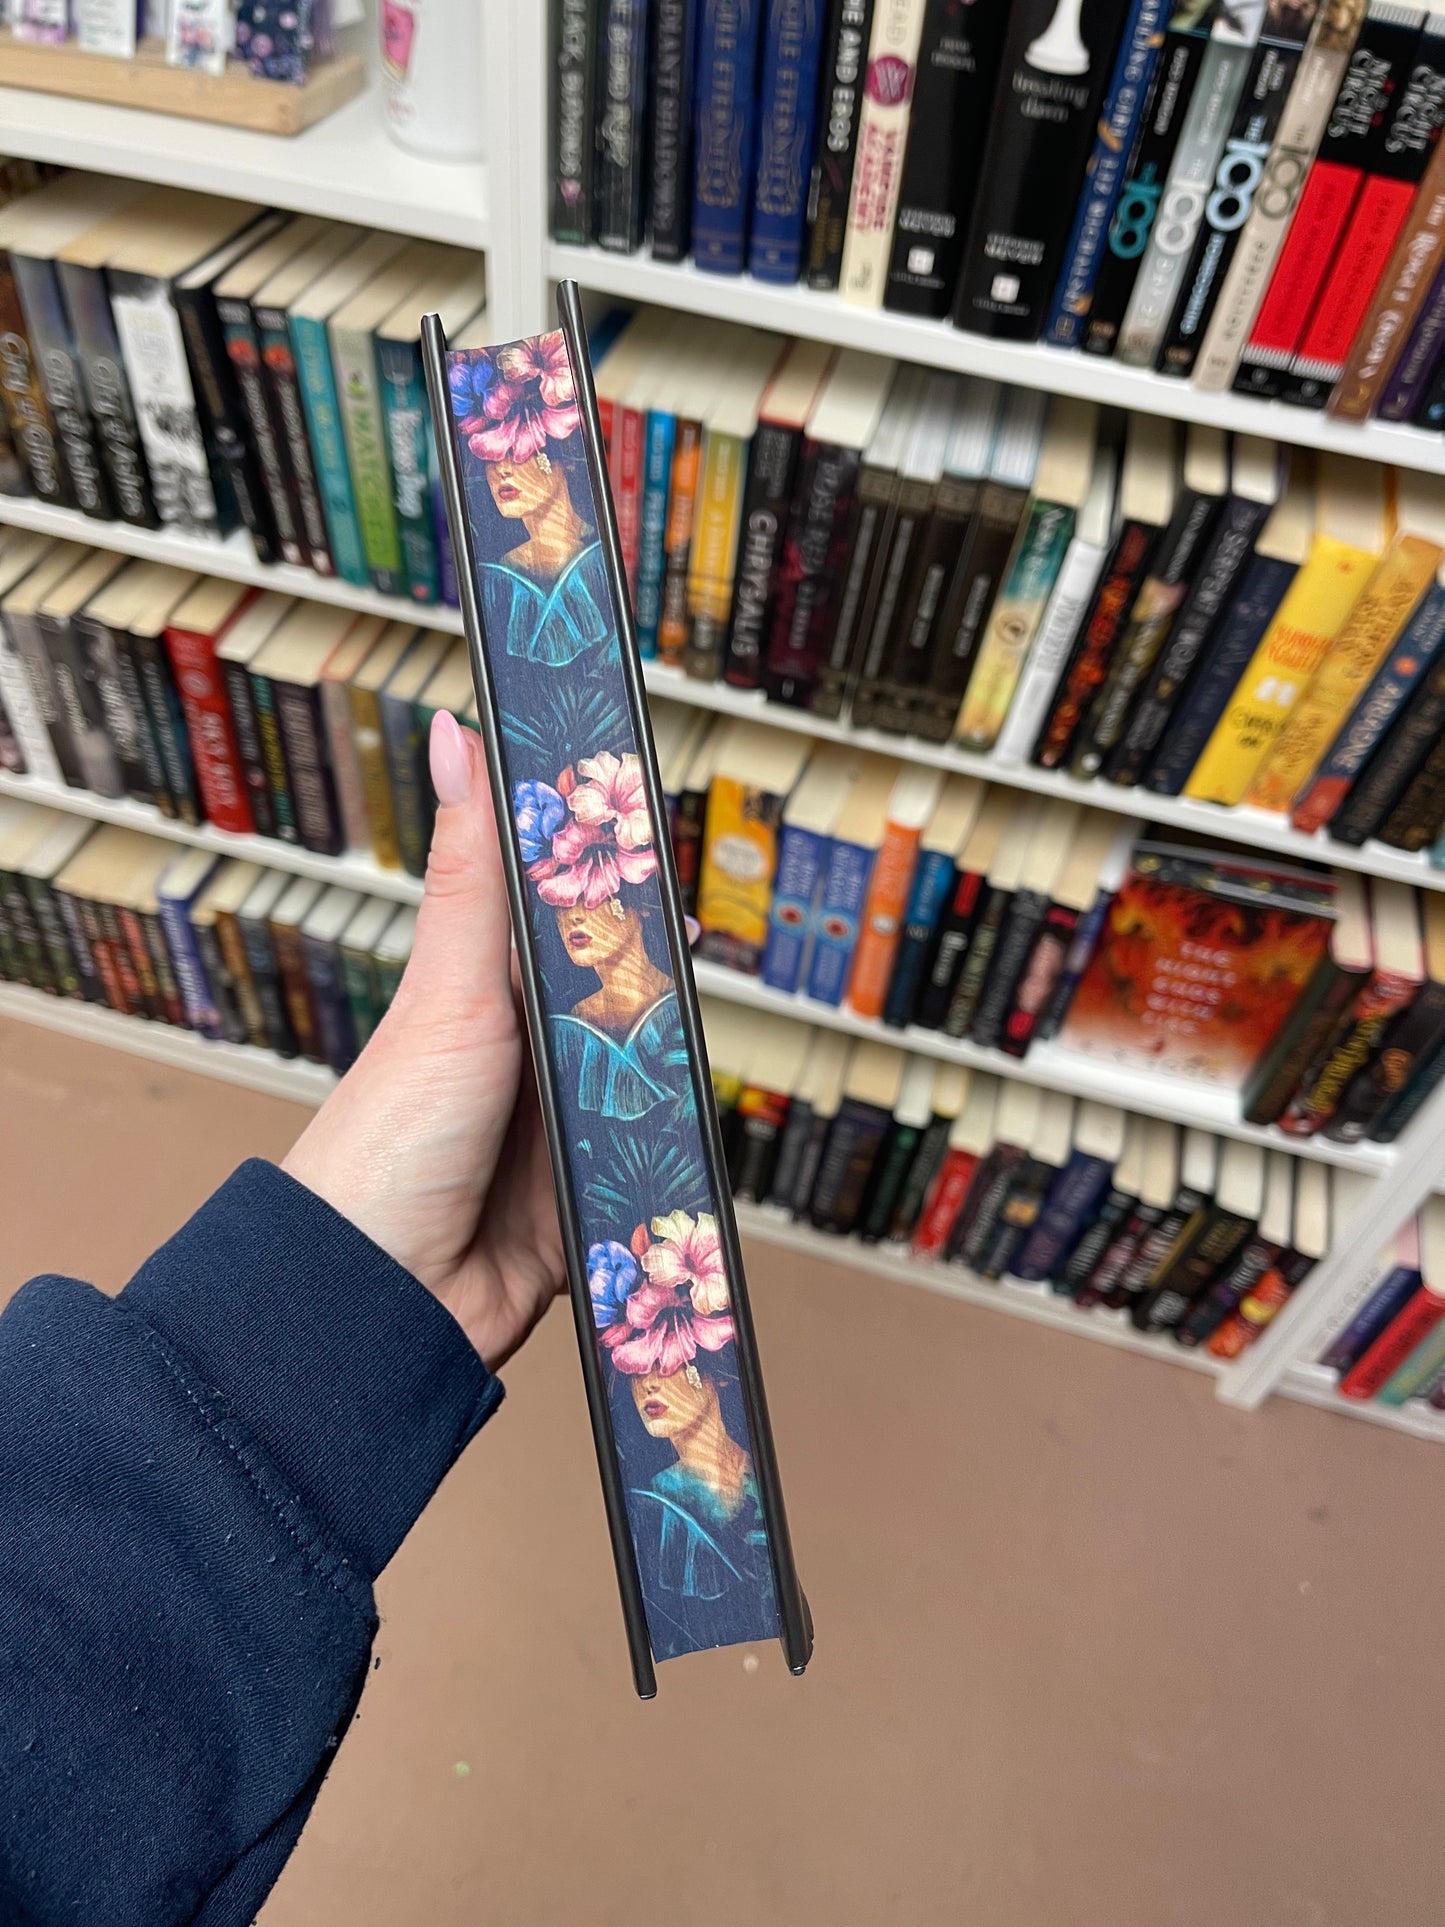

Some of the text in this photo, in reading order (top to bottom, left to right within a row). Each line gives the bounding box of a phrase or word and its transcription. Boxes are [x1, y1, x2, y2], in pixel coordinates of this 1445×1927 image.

[659, 0, 683, 92] DIANT
[826, 0, 866, 152] HE AND EROS
[1122, 0, 1161, 83] ARLING
[730, 508, 779, 657] CHRYSALIS
